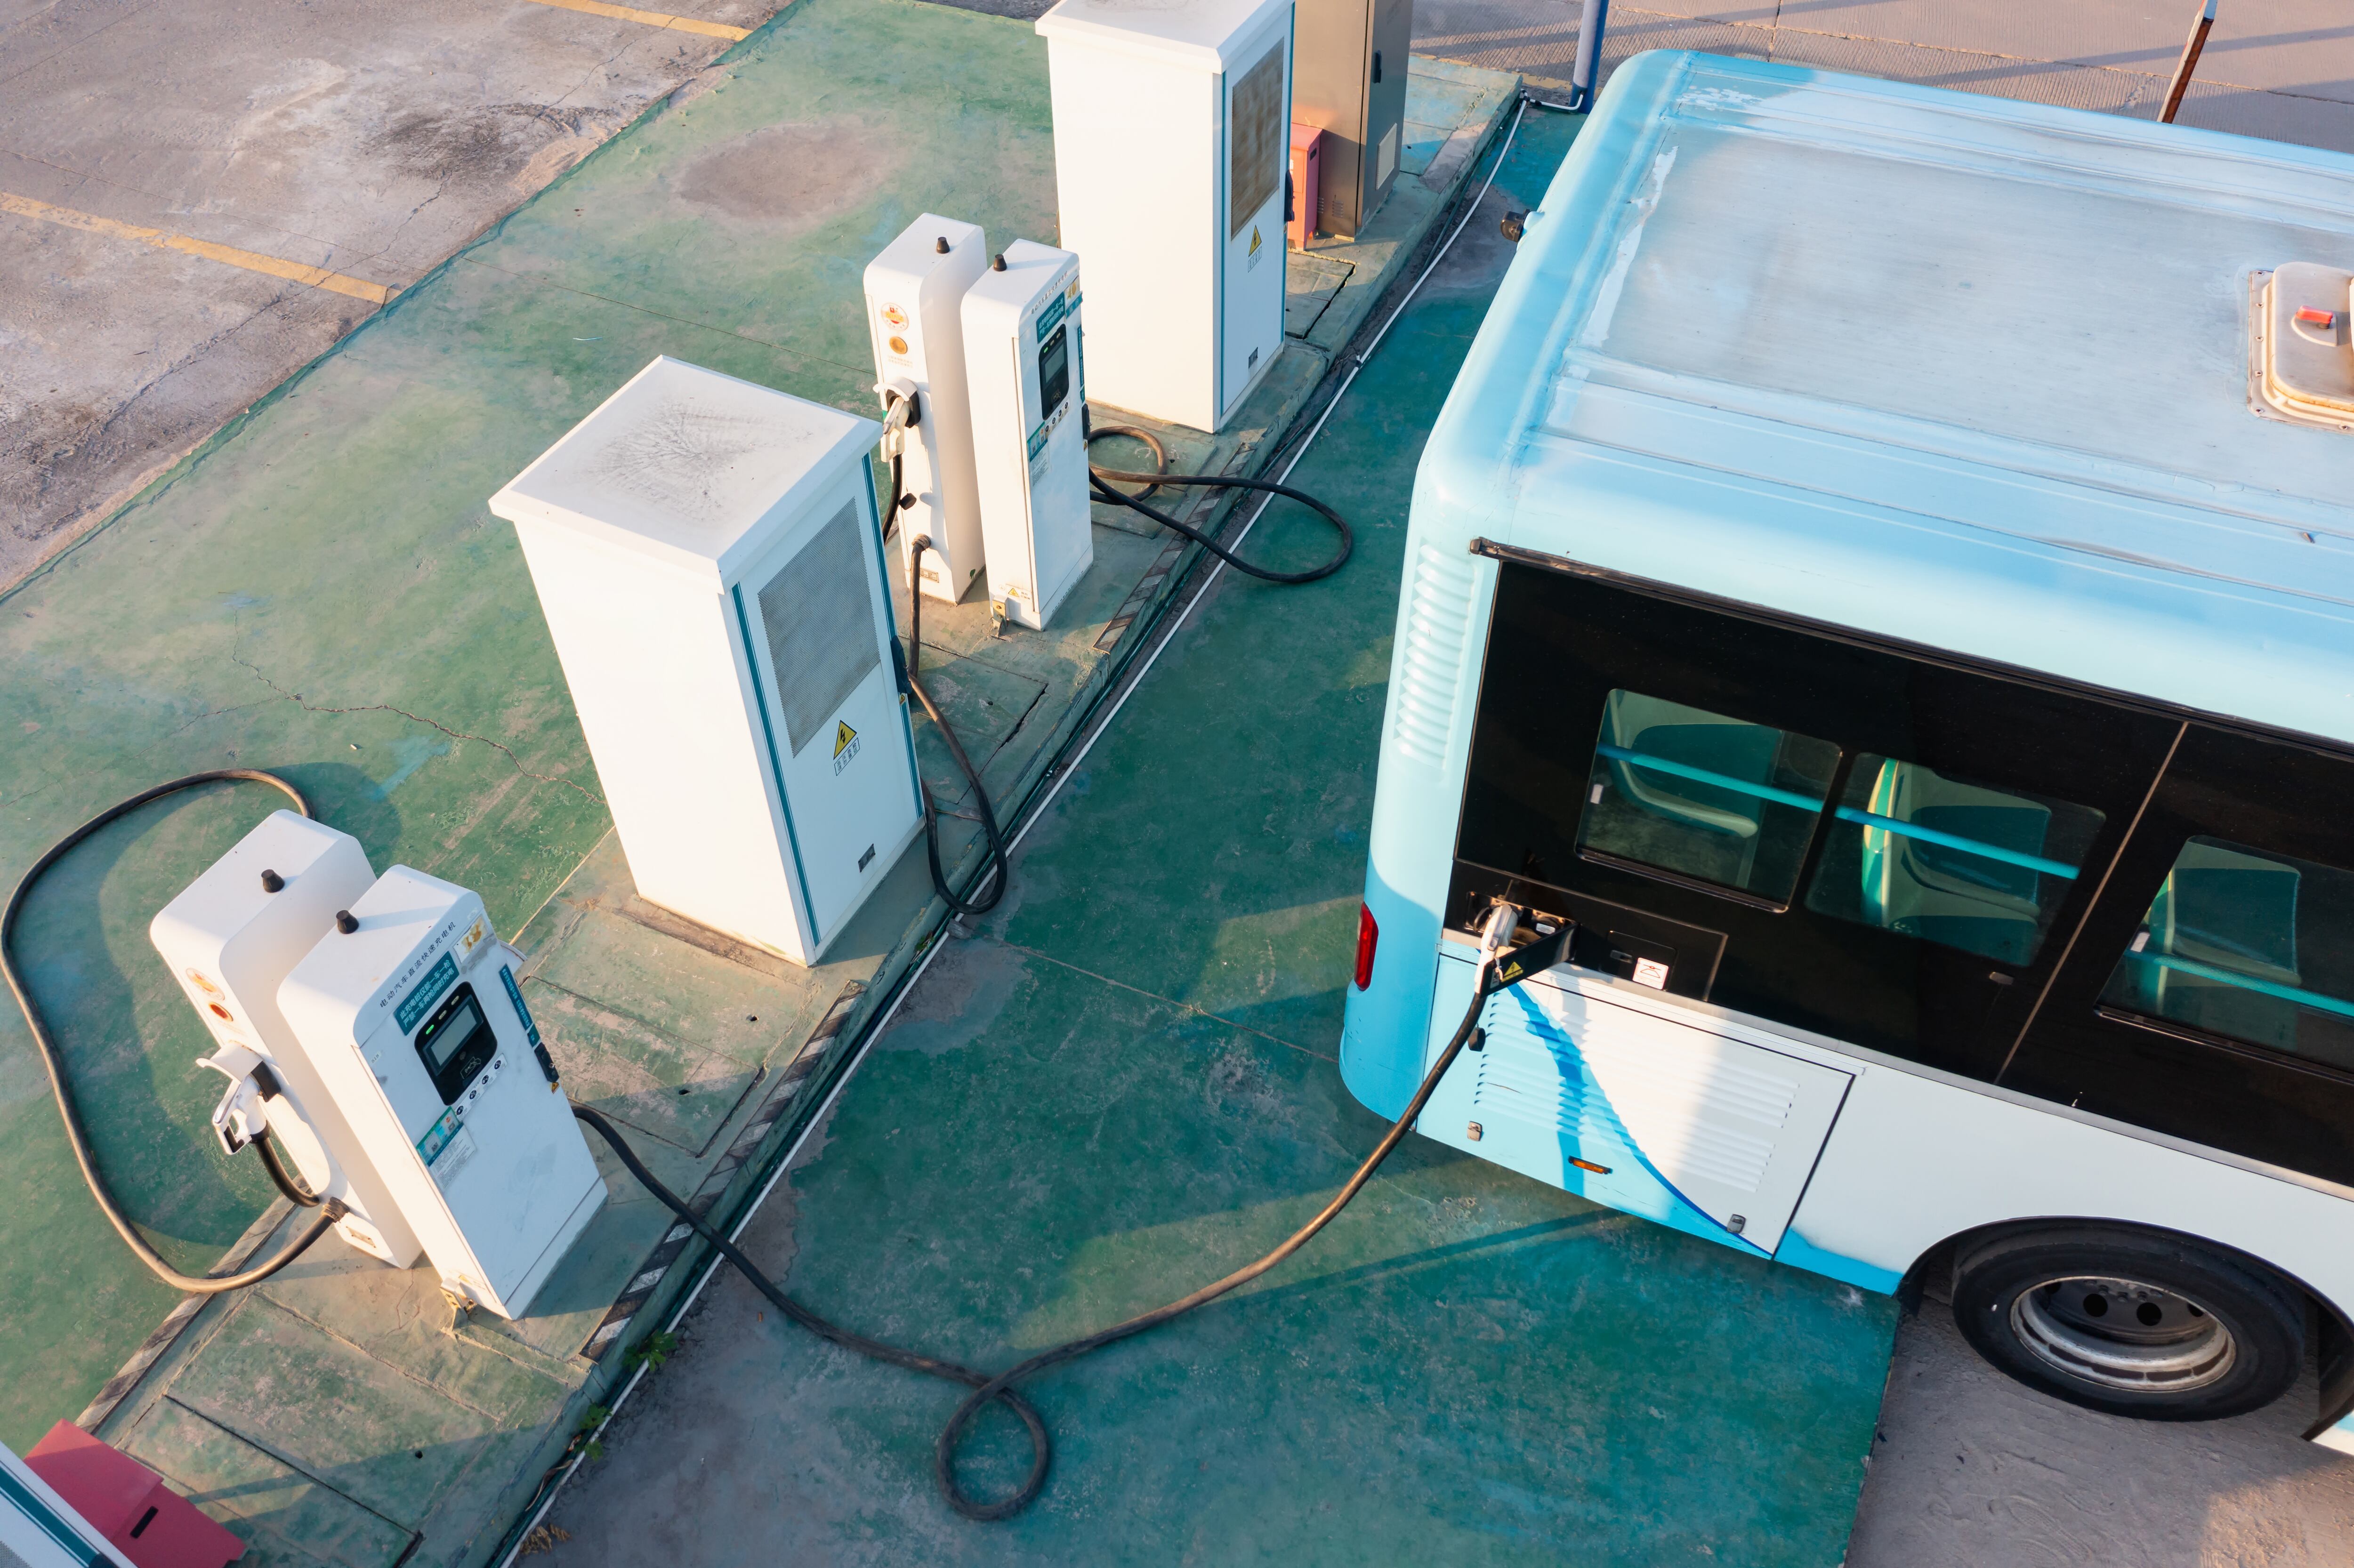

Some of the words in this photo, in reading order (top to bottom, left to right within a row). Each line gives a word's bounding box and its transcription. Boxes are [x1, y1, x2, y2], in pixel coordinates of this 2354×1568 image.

[380, 922, 456, 1008] 电动汽车直流快速充电机
[400, 959, 451, 1020] 此充电桩仅能一车一枪
[403, 968, 455, 1028] 严禁一车两枪同时充电
